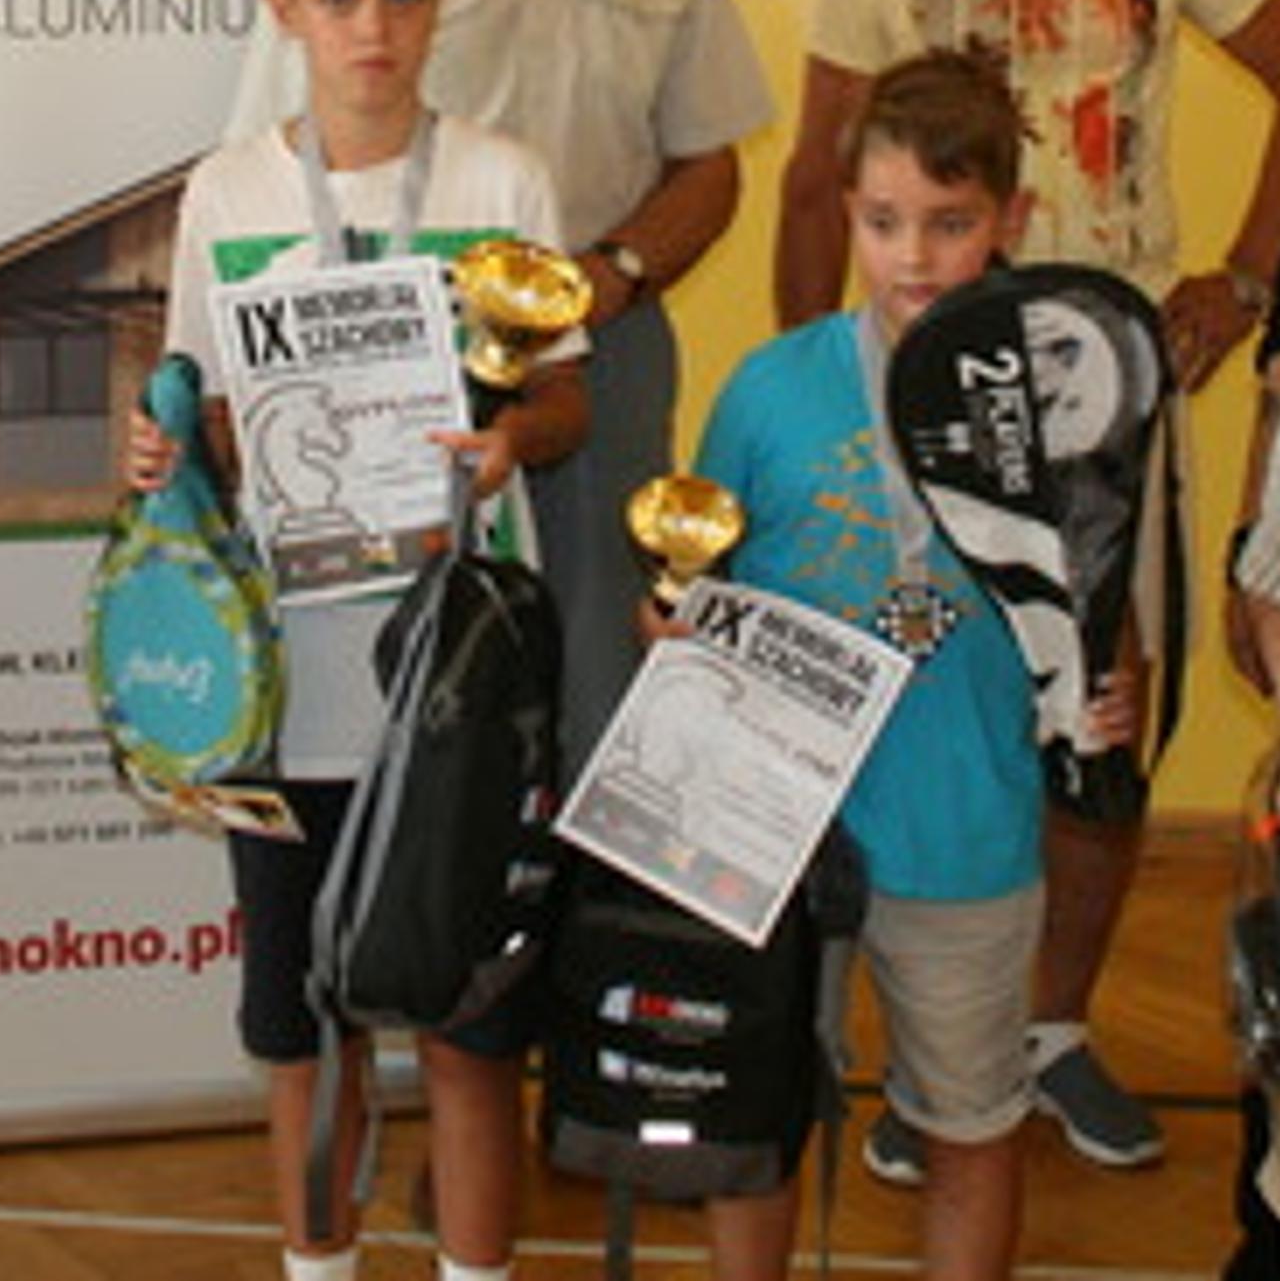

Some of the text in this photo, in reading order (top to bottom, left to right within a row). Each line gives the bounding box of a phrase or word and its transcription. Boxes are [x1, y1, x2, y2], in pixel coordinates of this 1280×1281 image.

[234, 296, 295, 369] IX
[299, 317, 429, 357] SZACHOWY
[956, 348, 1022, 391] 2
[694, 593, 757, 649] IX
